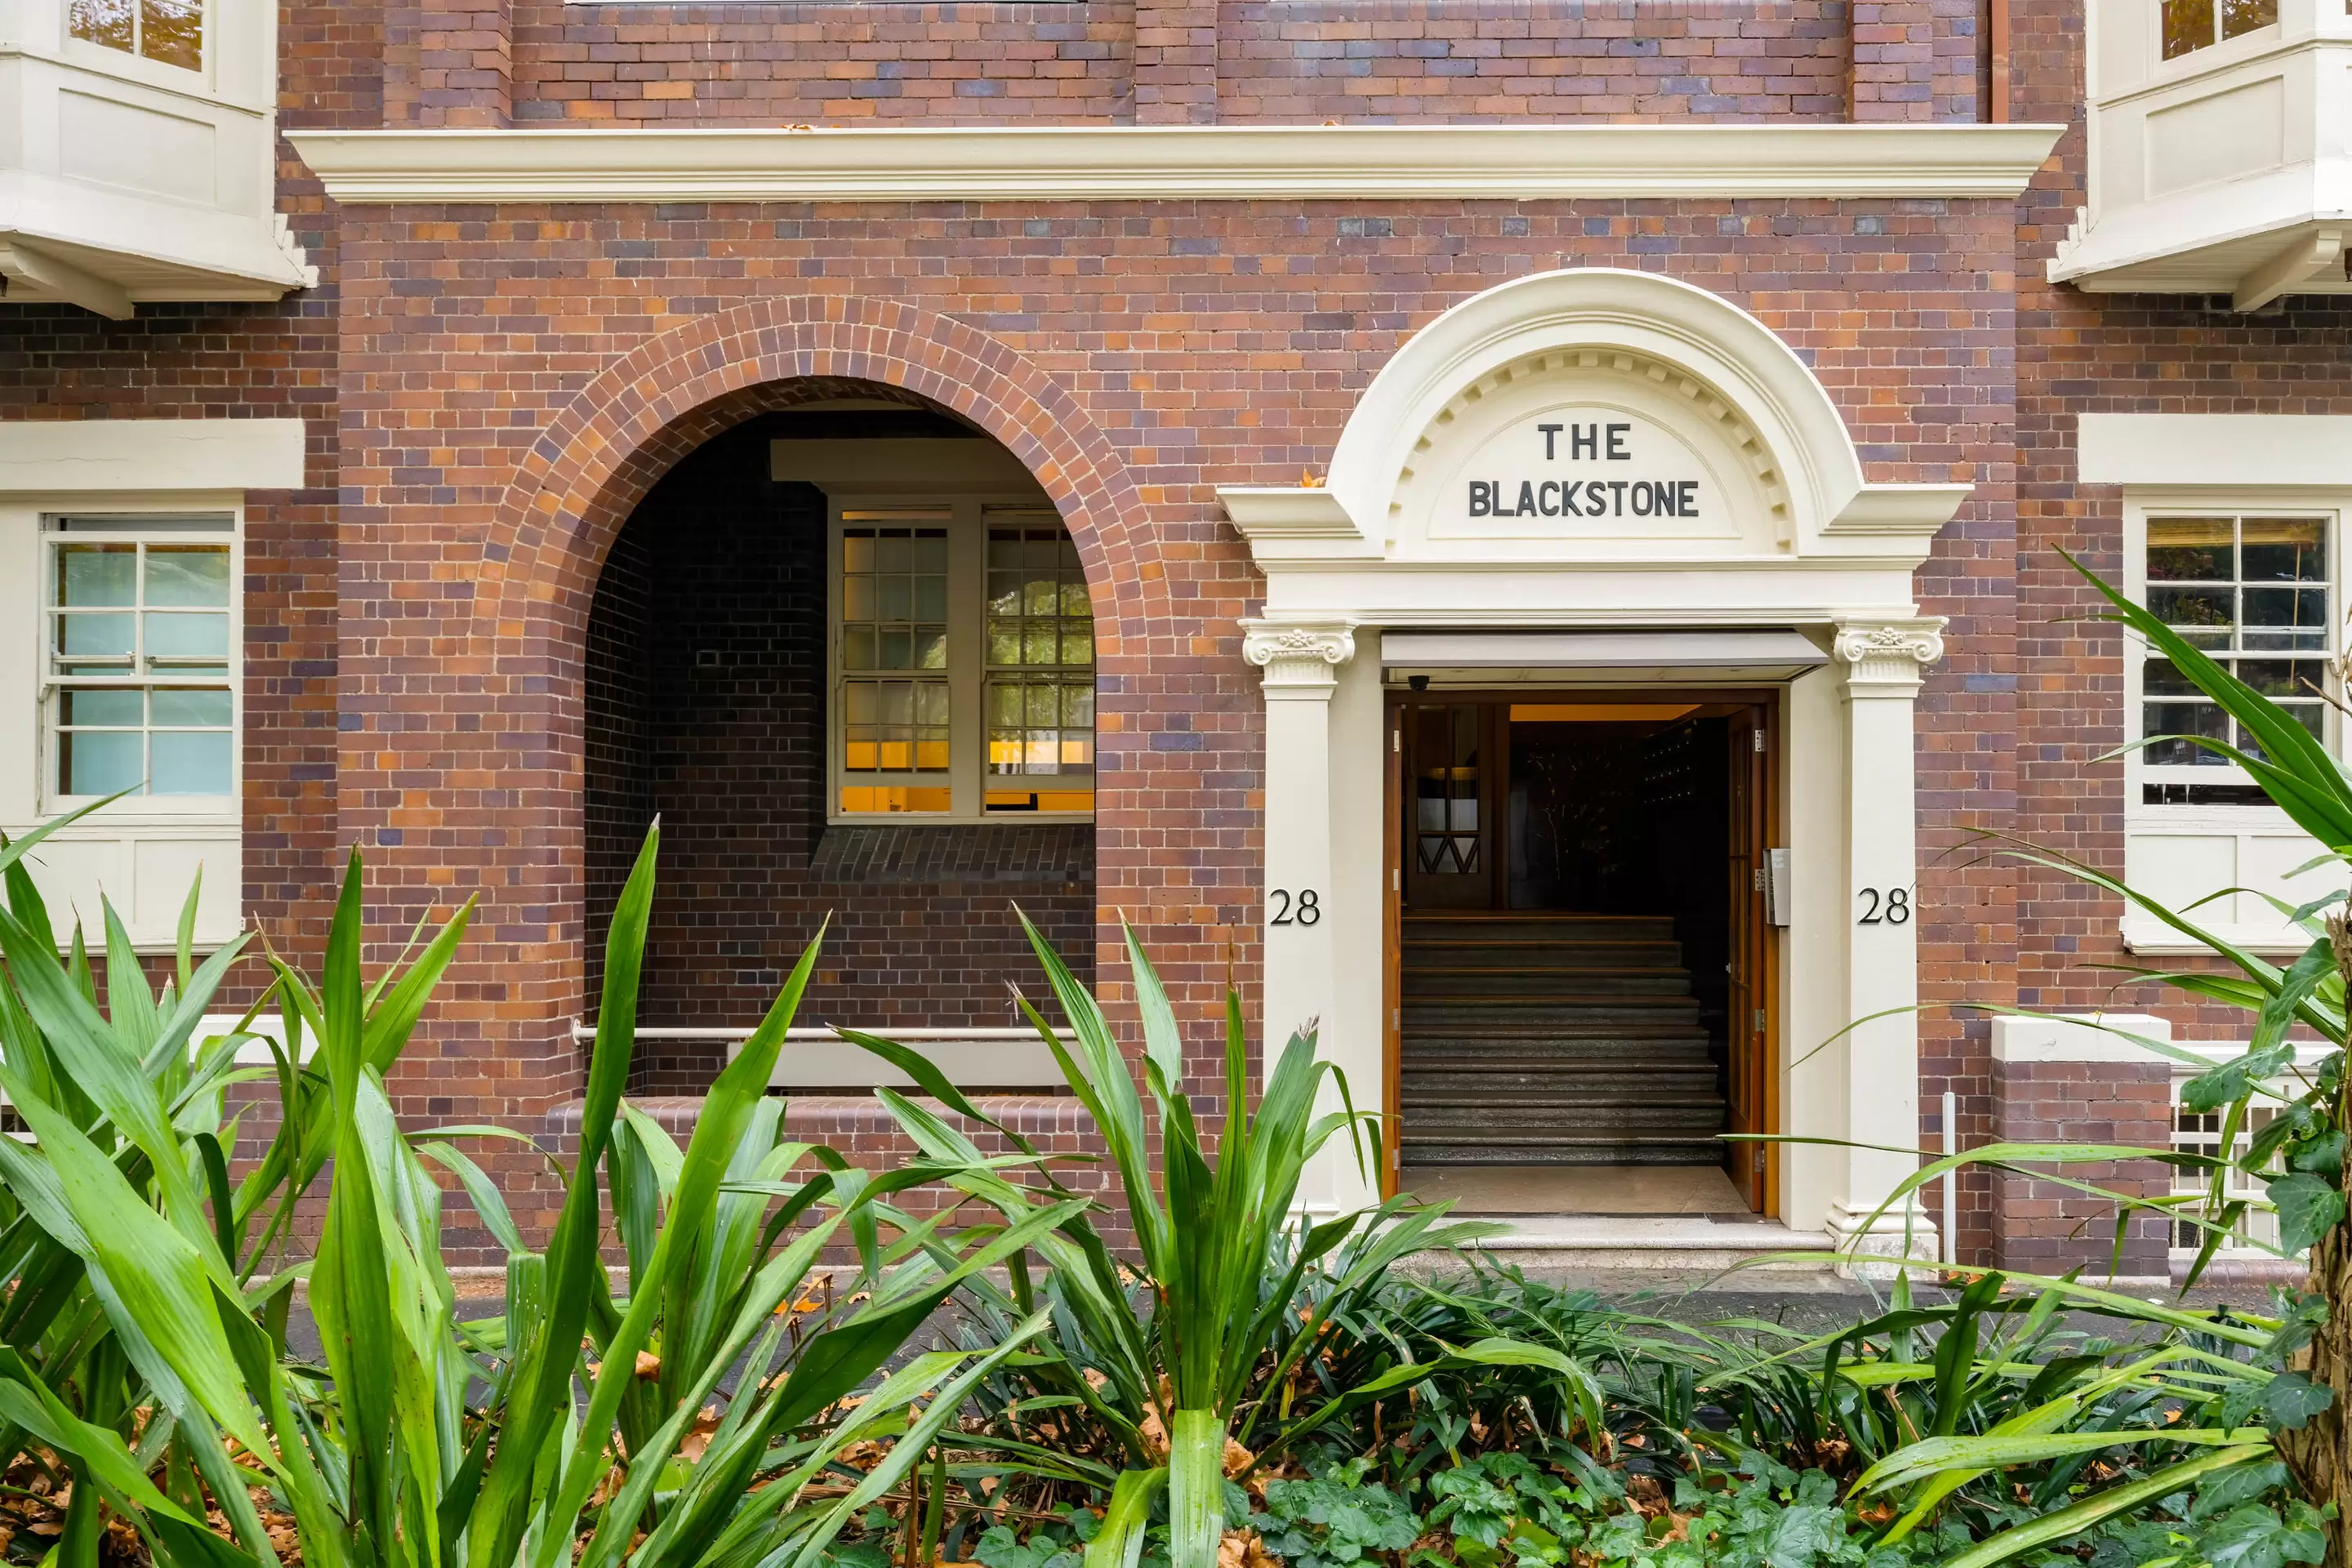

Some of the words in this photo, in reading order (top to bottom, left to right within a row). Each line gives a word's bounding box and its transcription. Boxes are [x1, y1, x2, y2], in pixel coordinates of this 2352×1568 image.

[1538, 424, 1631, 461] THE
[1469, 480, 1699, 517] BLACKSTONE
[1269, 889, 1321, 927] 28
[1857, 887, 1910, 925] 28
